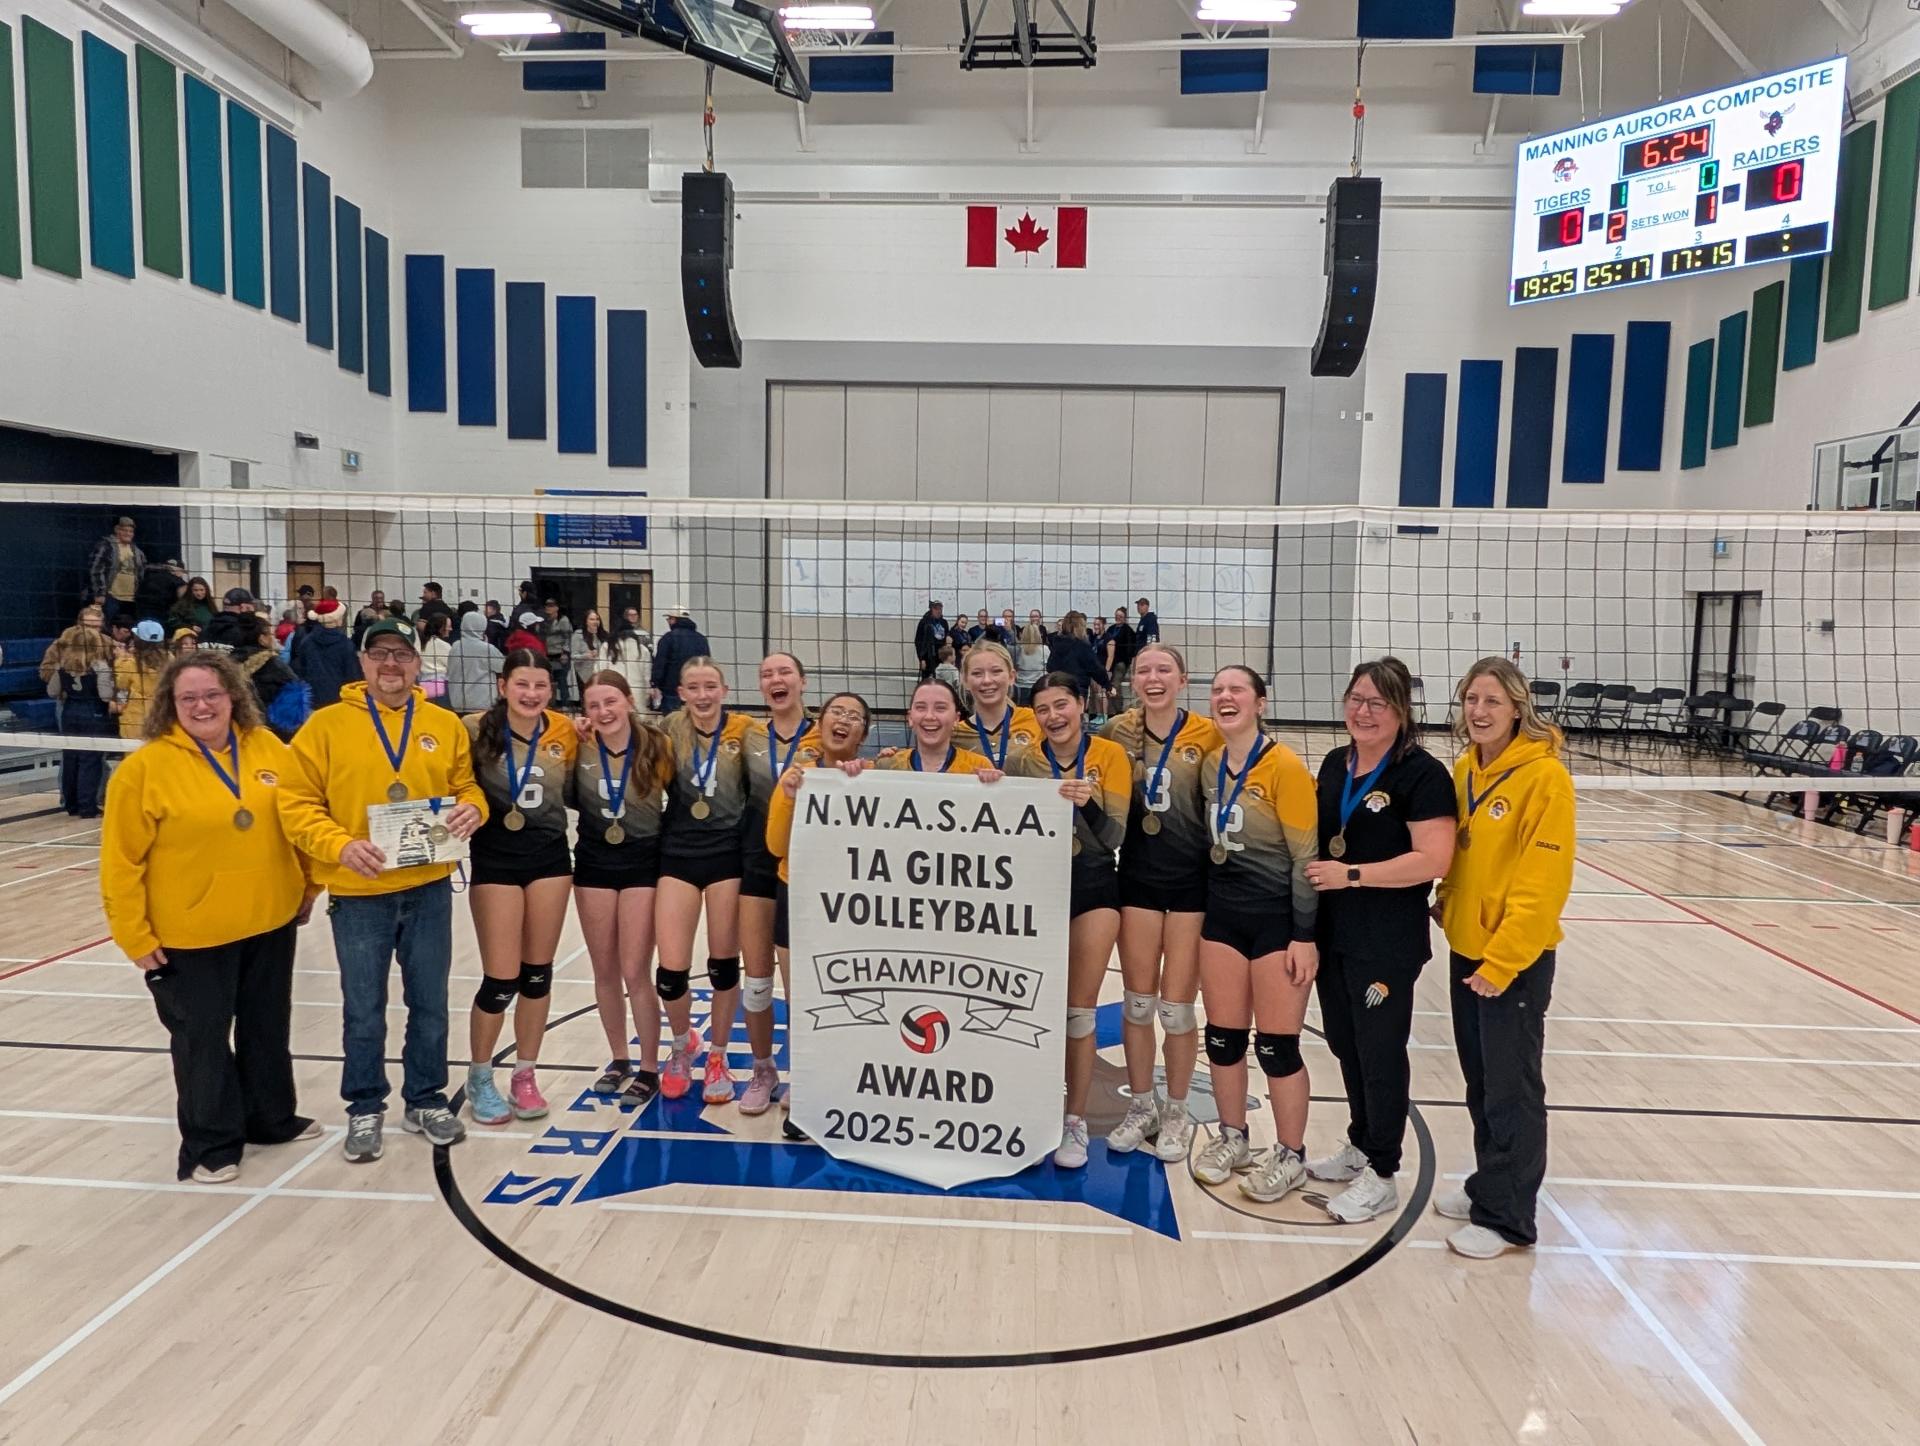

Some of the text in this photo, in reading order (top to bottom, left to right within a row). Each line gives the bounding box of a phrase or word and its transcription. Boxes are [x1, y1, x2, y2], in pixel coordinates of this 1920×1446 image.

[1526, 67, 1834, 161] MANNING AURORA COMPOSITE
[1643, 128, 1708, 169] 6:24
[1733, 135, 1820, 167] RAIDERS
[1701, 163, 1718, 189] 0
[1776, 163, 1800, 201] 0
[1534, 187, 1591, 211] TIGERS
[1563, 210, 1582, 244] 0
[1609, 213, 1626, 241] 2
[1631, 209, 1689, 228] SETS WON
[1782, 214, 1790, 224] 4
[1614, 246, 1623, 256] 2
[1695, 231, 1702, 241] 3
[1542, 260, 1548, 270] 1
[1587, 257, 1651, 288] 25:17
[1671, 242, 1732, 272] 17:15
[1523, 271, 1574, 298] 19:25
[516, 766, 545, 809] 6
[691, 759, 718, 797] 4
[805, 793, 1056, 838] N.W.A.S.A.A.
[847, 847, 1014, 891] 1A GIRLS
[820, 892, 1038, 937] VOLLEYBALL
[826, 957, 1028, 1000] CHAMPIONS
[856, 1062, 994, 1104] AWARD
[823, 1109, 1026, 1158] 2025-2026
